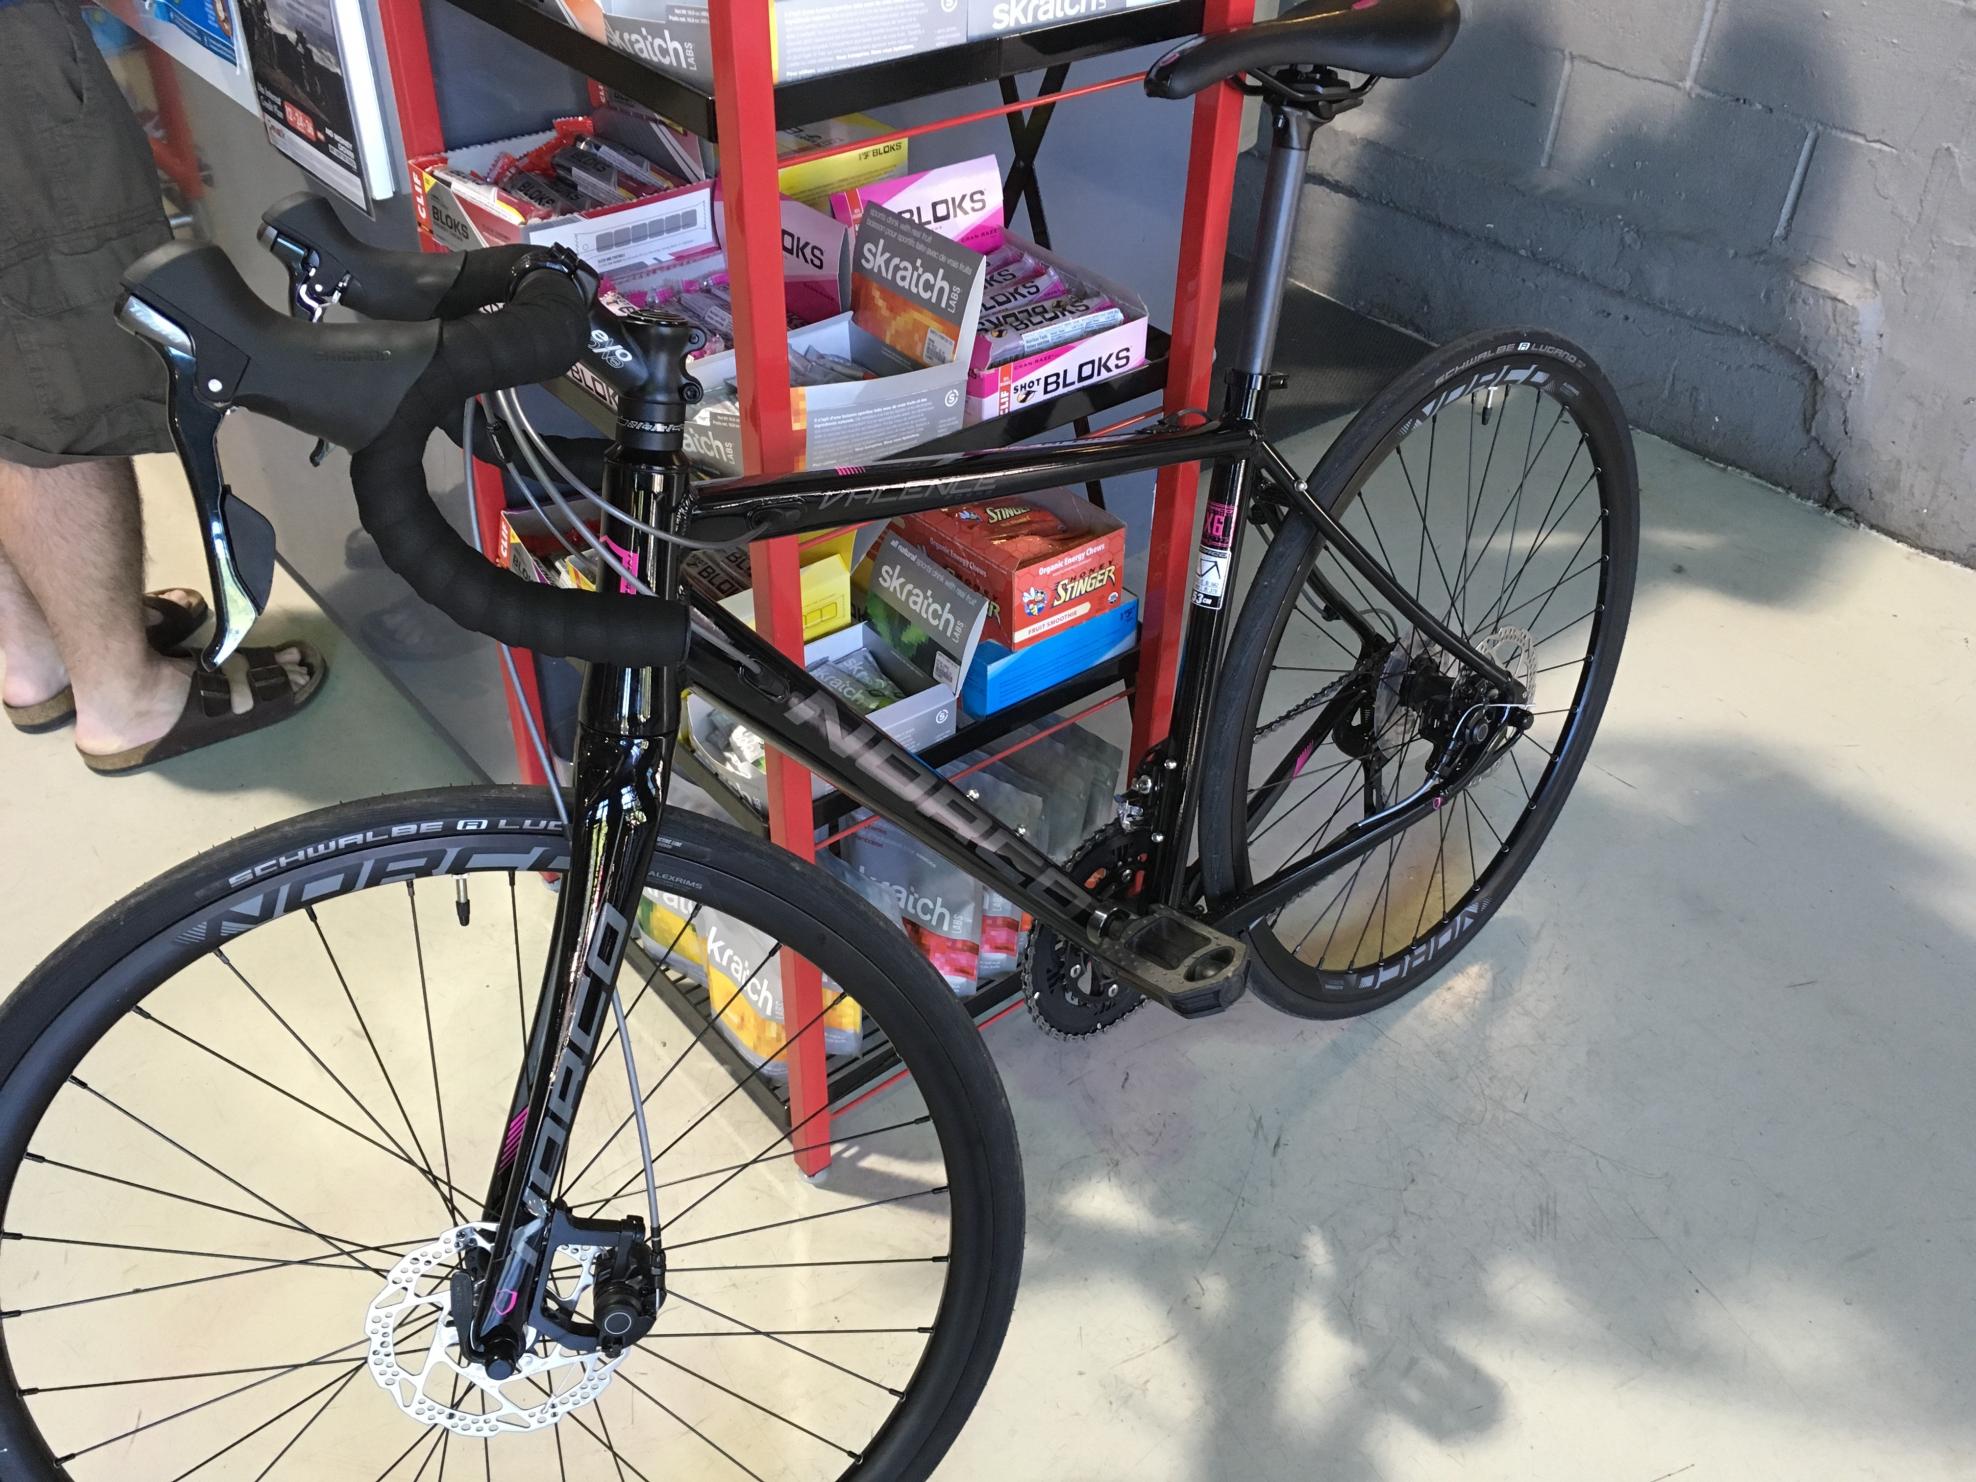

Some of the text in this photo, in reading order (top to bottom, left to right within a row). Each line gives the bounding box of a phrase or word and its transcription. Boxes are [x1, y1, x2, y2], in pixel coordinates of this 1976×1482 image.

[684, 41, 697, 71] LABS
[872, 142, 903, 158] BLOKS
[412, 171, 427, 219] CLIF
[431, 205, 469, 240] BLOKS
[782, 228, 824, 271] OKS
[861, 238, 950, 309] skratch
[947, 285, 961, 314] LABS
[980, 281, 1041, 313] LOKS
[1043, 347, 1130, 396] BLOKS
[1434, 343, 1516, 387] SCHWALBE
[1530, 343, 1577, 364] LUGANO
[570, 365, 619, 406] BLOK
[1013, 377, 1042, 394] SHOT
[683, 426, 727, 462] atch
[818, 477, 998, 511] VALENCE
[986, 503, 1031, 525] STINGE
[513, 554, 530, 581] BLO
[897, 544, 918, 562] natural
[1038, 543, 1105, 576] Organic Energy Chews
[698, 565, 737, 596] BLO
[1052, 565, 1116, 608] STINGER
[1070, 559, 1114, 583] HONEY
[879, 564, 955, 637] skratch
[952, 620, 965, 644] LABS
[1027, 610, 1078, 635] FRUIT SMOOTHIE
[814, 665, 866, 705] kratch
[783, 691, 1098, 922] NORCO
[228, 823, 443, 888] SCHWALBE
[647, 870, 703, 890] ALEXRIMS
[888, 884, 951, 932] atch
[951, 913, 964, 934] LABS
[706, 926, 773, 1016] kratch
